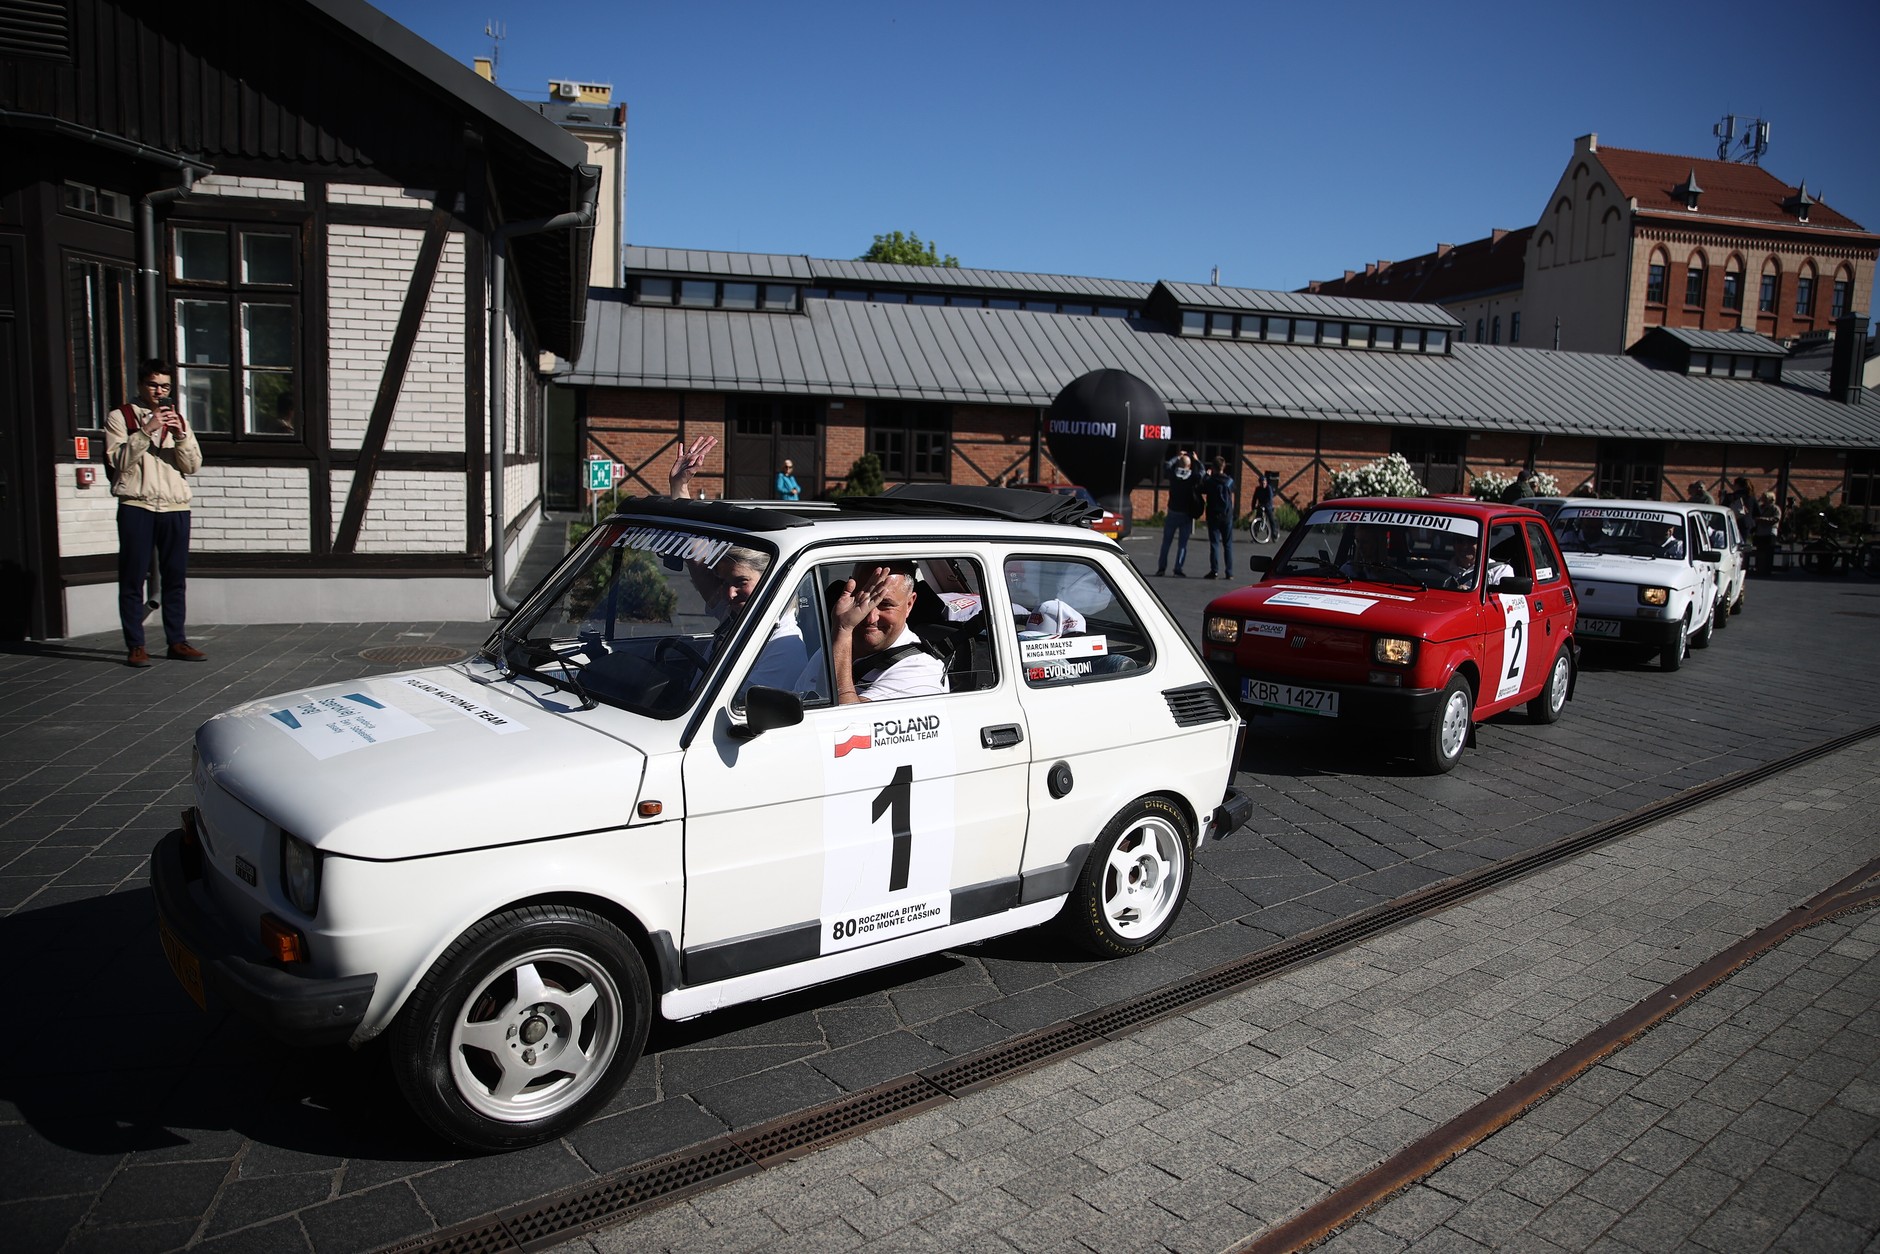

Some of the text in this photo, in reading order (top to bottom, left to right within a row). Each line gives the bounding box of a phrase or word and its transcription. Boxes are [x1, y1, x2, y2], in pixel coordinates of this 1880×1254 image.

[1045, 420, 1116, 438] EVOLUTION]
[1330, 511, 1452, 530] [126EVOLUTION]
[605, 526, 734, 569] EVOLUTION]
[1584, 620, 1619, 632] 14277
[1026, 642, 1049, 651] MARCIN
[1507, 620, 1522, 679] 2
[402, 679, 507, 726] POLAND NATIONAL TEAM
[1249, 680, 1279, 702] KBR
[1286, 687, 1334, 710] 14271
[874, 715, 940, 738] POLAND
[874, 730, 939, 747] NATIONAL TEAM
[872, 765, 912, 892] 1
[858, 903, 927, 926] ROCZNICA BITWY
[858, 907, 941, 934] POD MONTE CASSINO
[833, 918, 857, 941] 80
